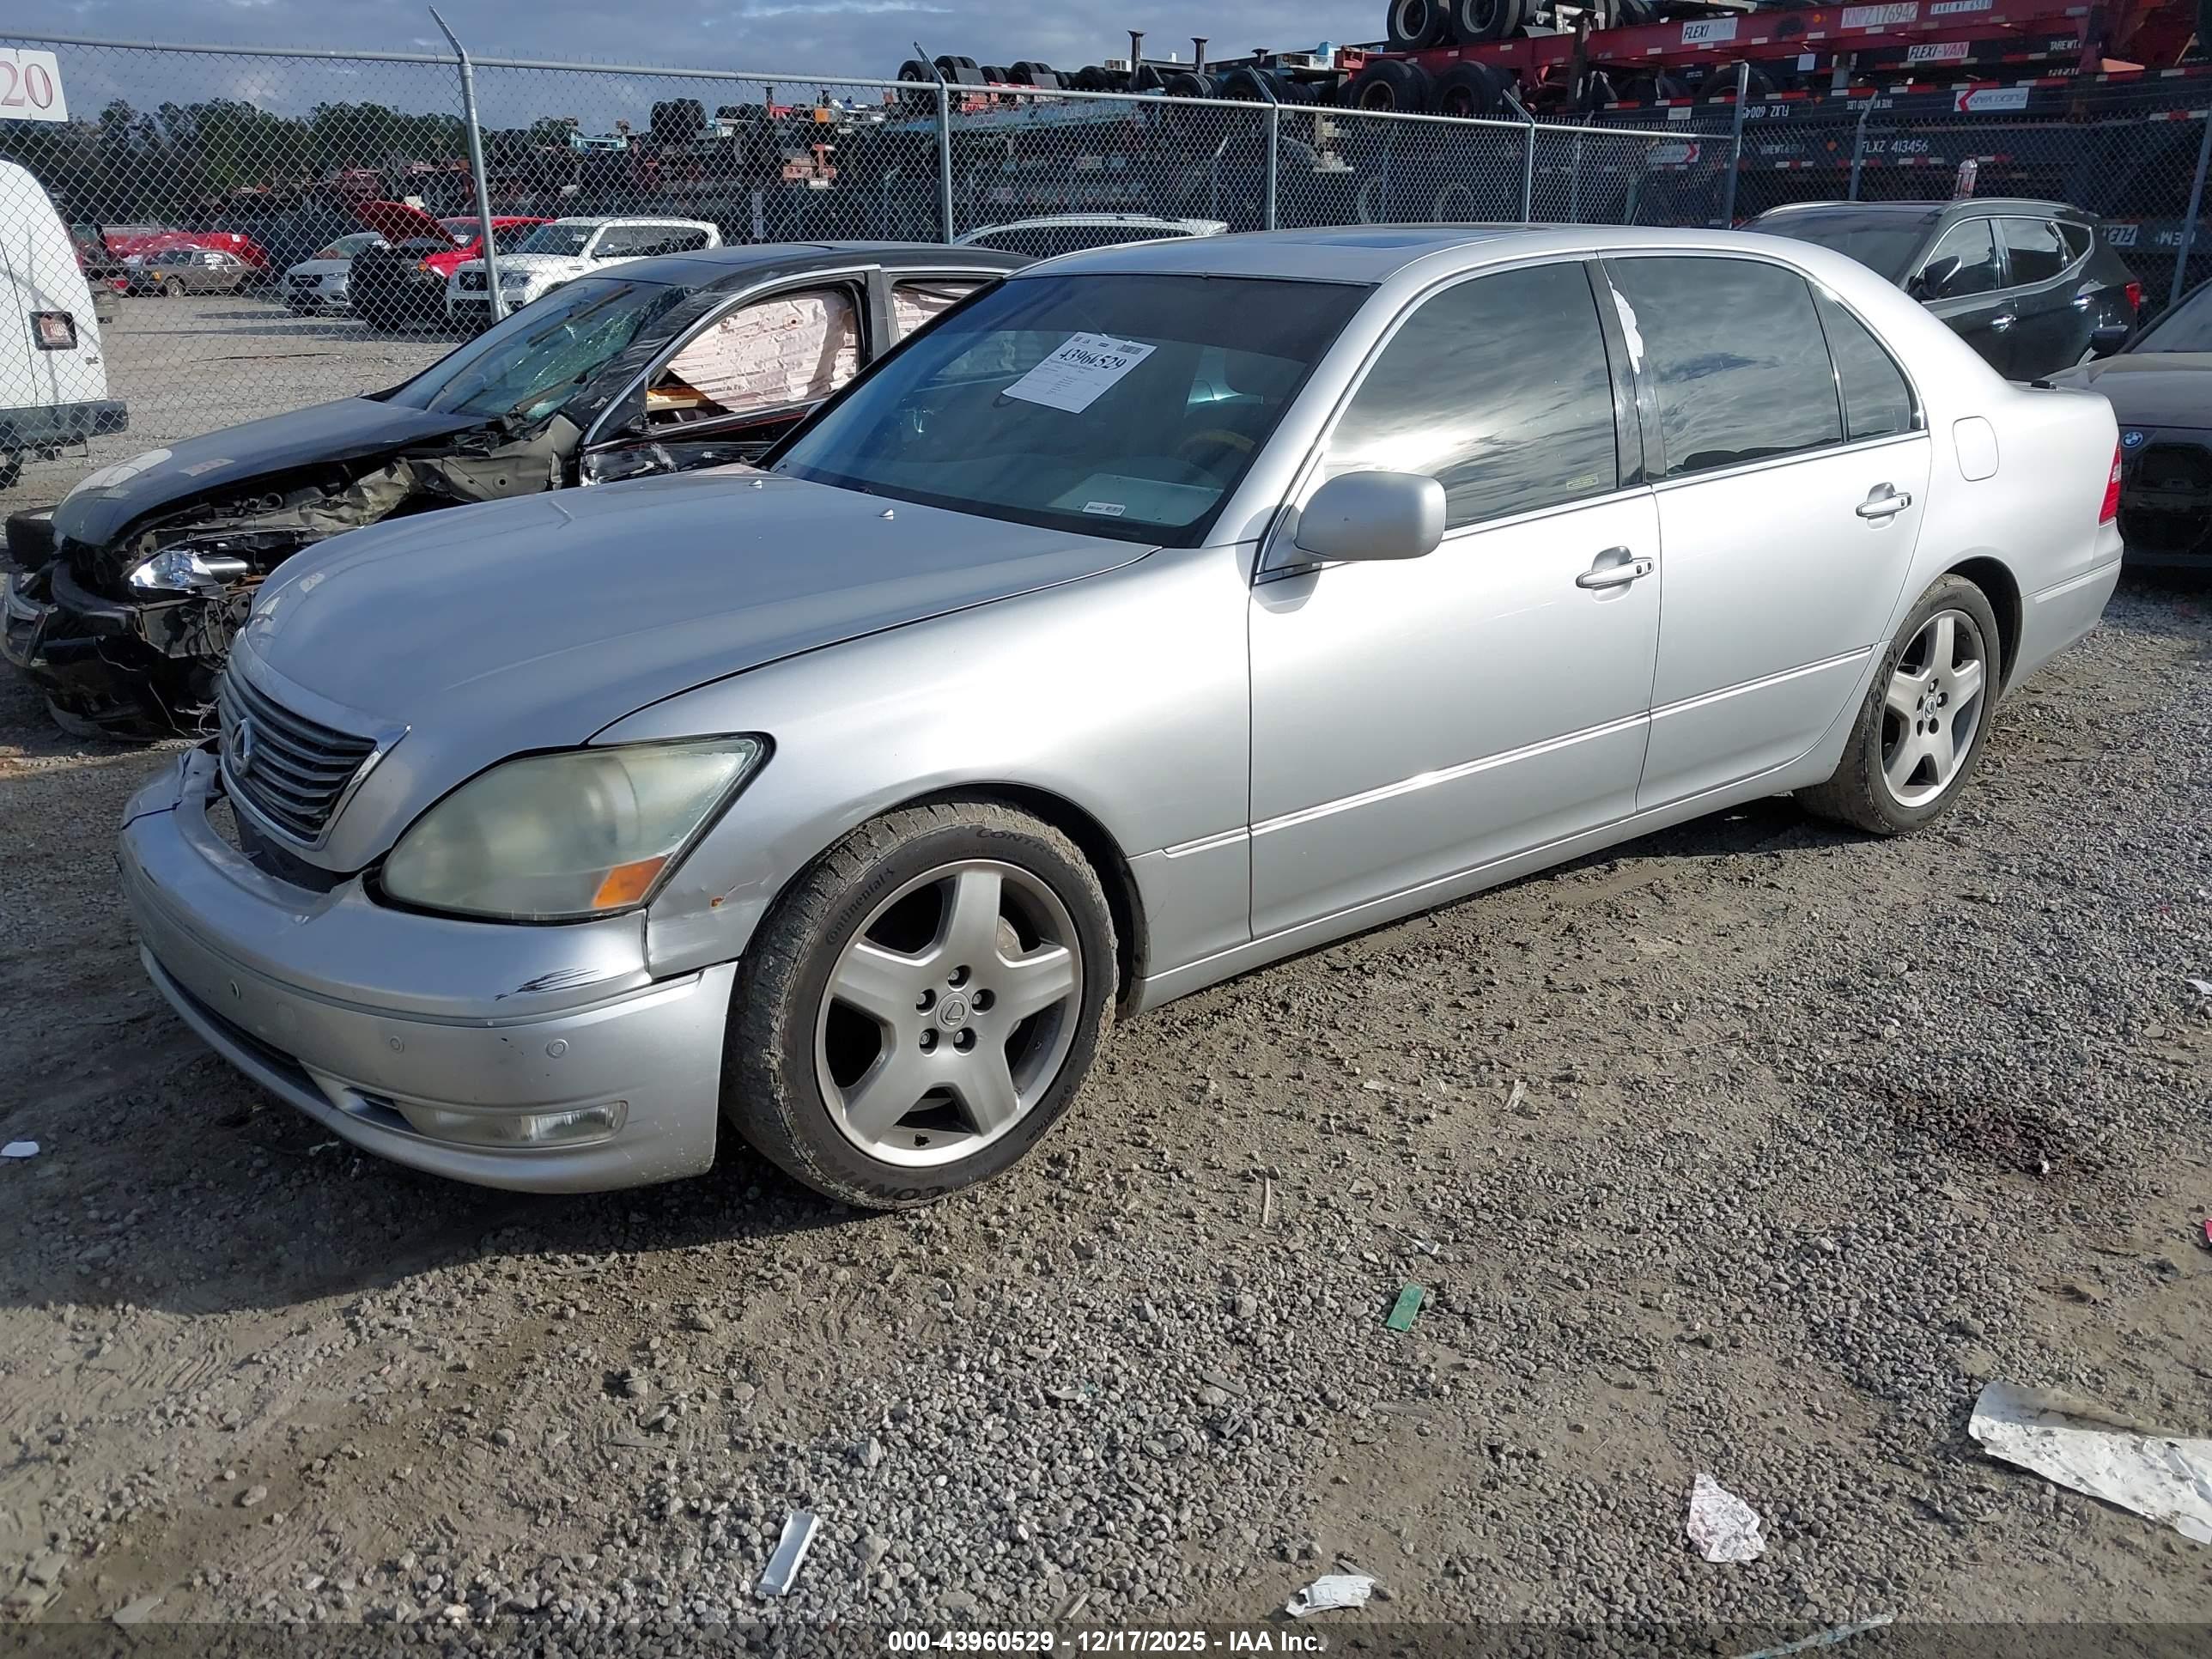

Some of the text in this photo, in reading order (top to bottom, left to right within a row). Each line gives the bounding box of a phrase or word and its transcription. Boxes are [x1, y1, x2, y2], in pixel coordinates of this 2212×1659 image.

[1910, 43, 1968, 59] FLEXI-VAN
[1770, 104, 1790, 118] FLXZ
[1862, 139, 1929, 153] FLXZ 413456
[1059, 347, 1127, 370] 43960529
